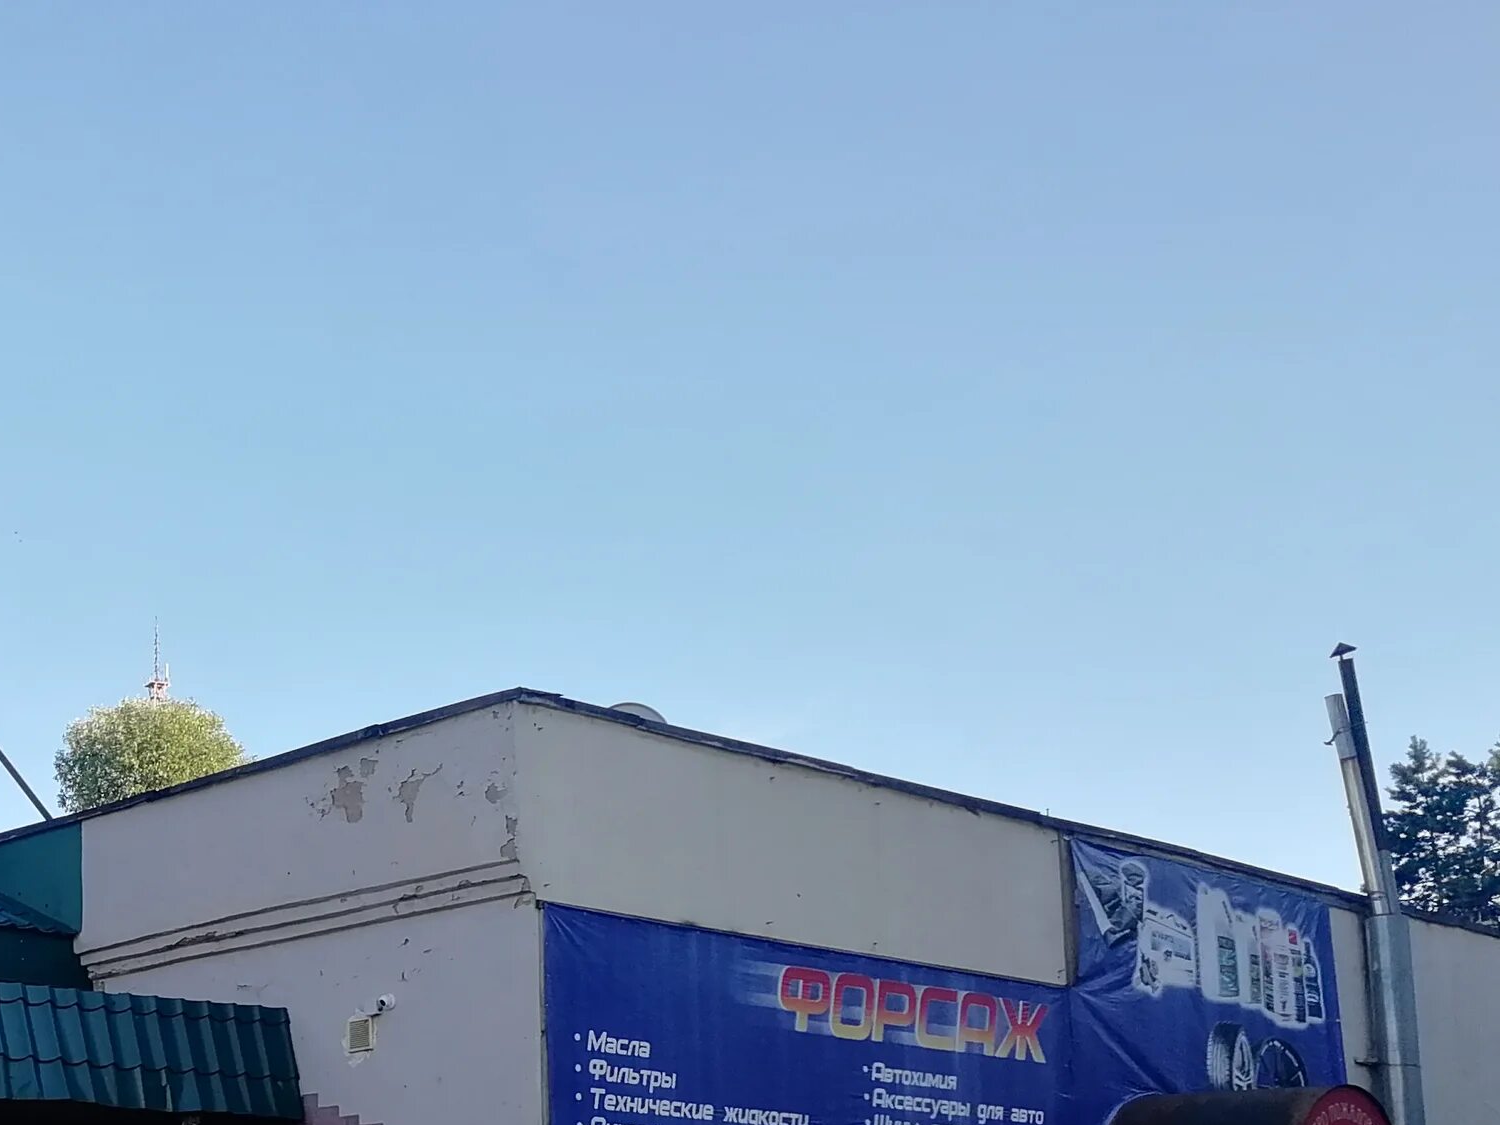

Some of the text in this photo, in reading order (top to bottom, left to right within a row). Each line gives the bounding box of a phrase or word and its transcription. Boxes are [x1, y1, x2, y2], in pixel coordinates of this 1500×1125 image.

[777, 966, 1048, 1063] ФОРСАЖ
[587, 1030, 651, 1058] Масла
[588, 1059, 677, 1093] Фильтры
[871, 1062, 957, 1090] Автохимия
[590, 1088, 714, 1121] Технические
[872, 1088, 1045, 1125] Аксессуары для авто
